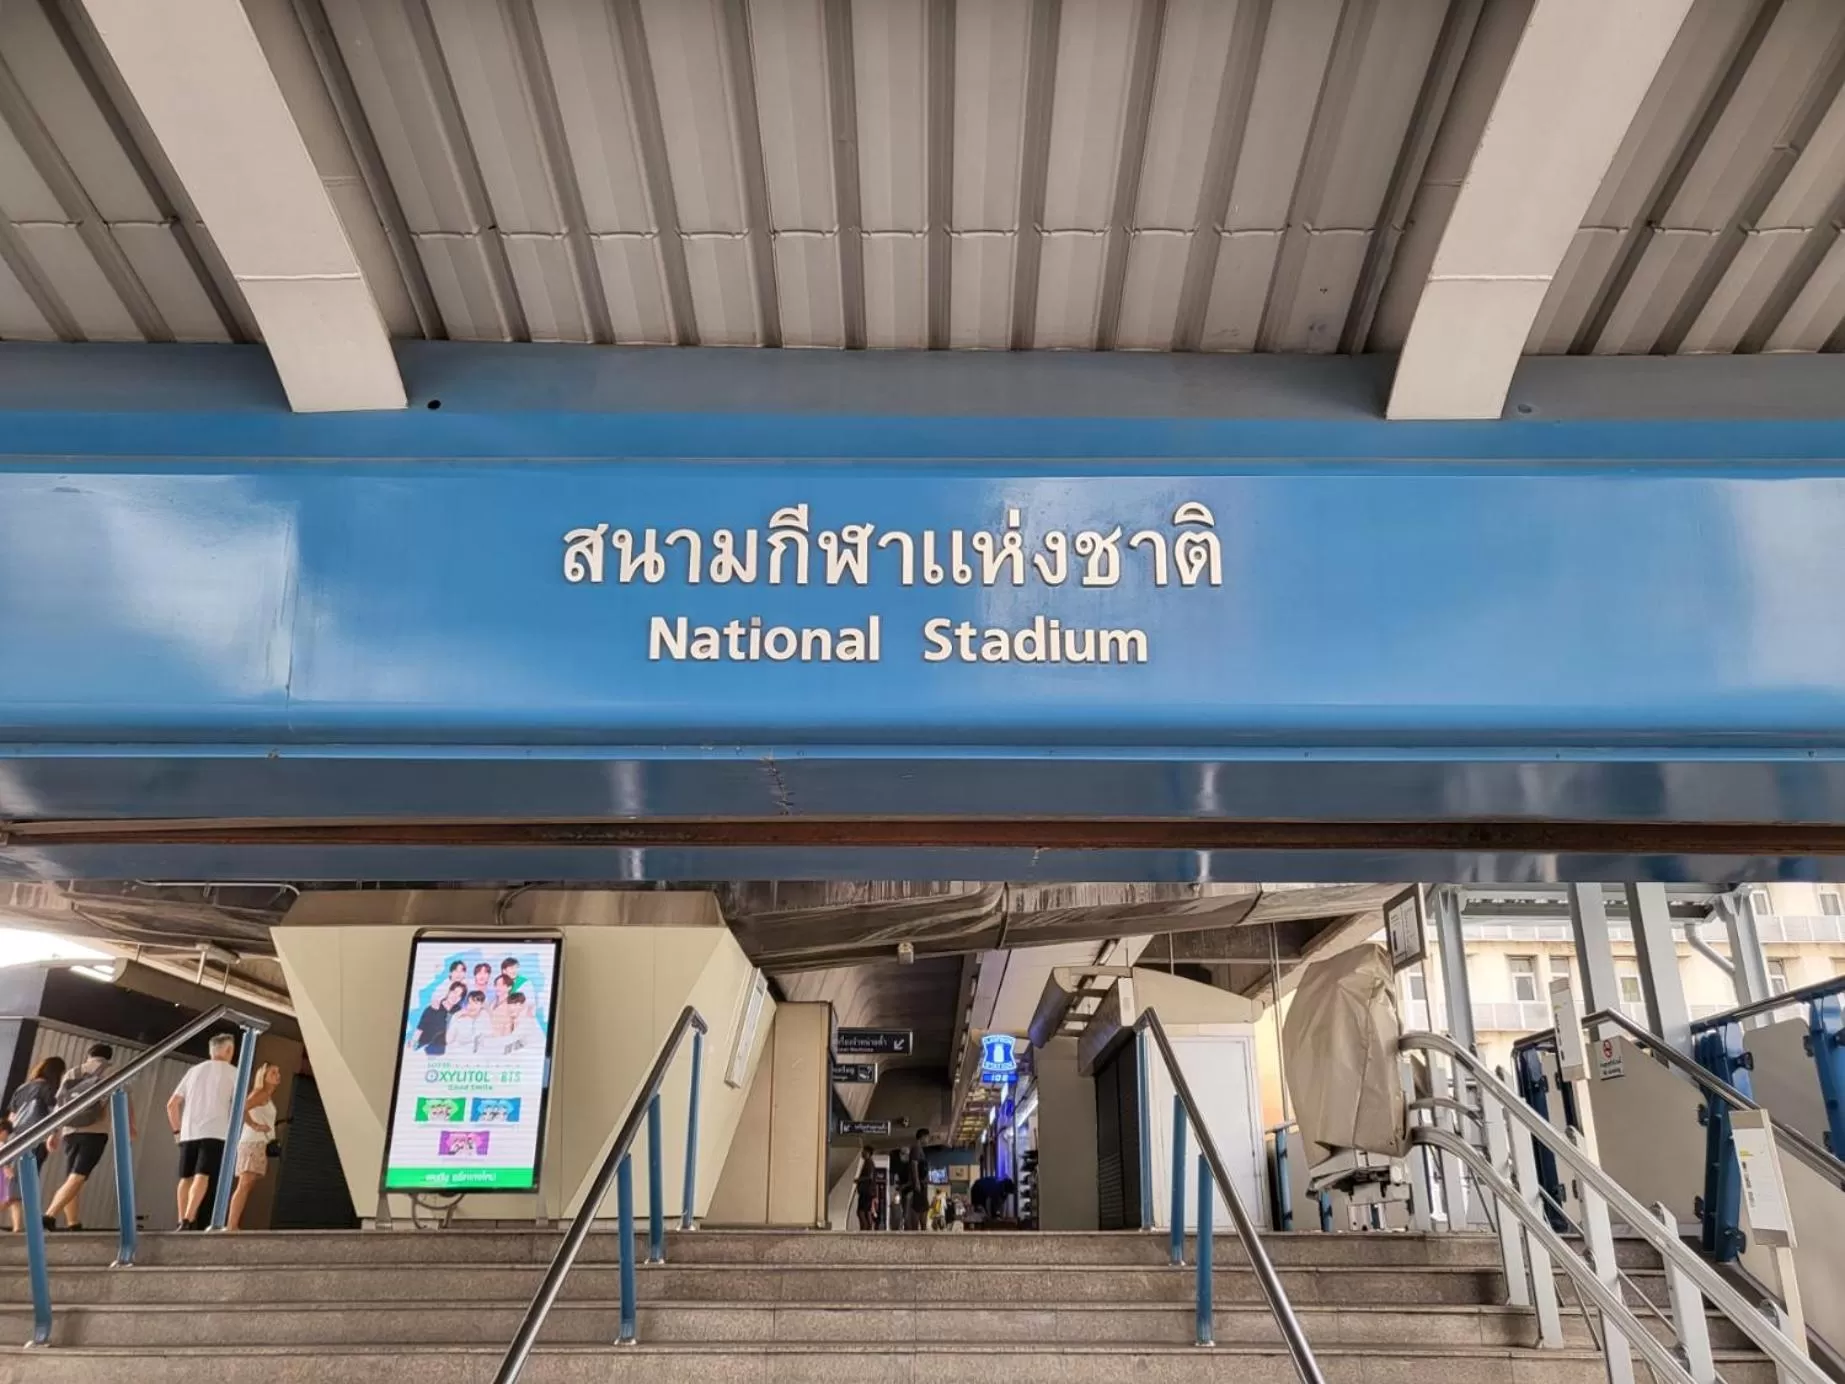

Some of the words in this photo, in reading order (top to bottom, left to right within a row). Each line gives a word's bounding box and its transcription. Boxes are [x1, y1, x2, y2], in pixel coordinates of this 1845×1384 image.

[563, 502, 1223, 586] สนามกีฬาแห่งชาติ
[648, 615, 881, 662] National
[923, 615, 1149, 663] Stadium
